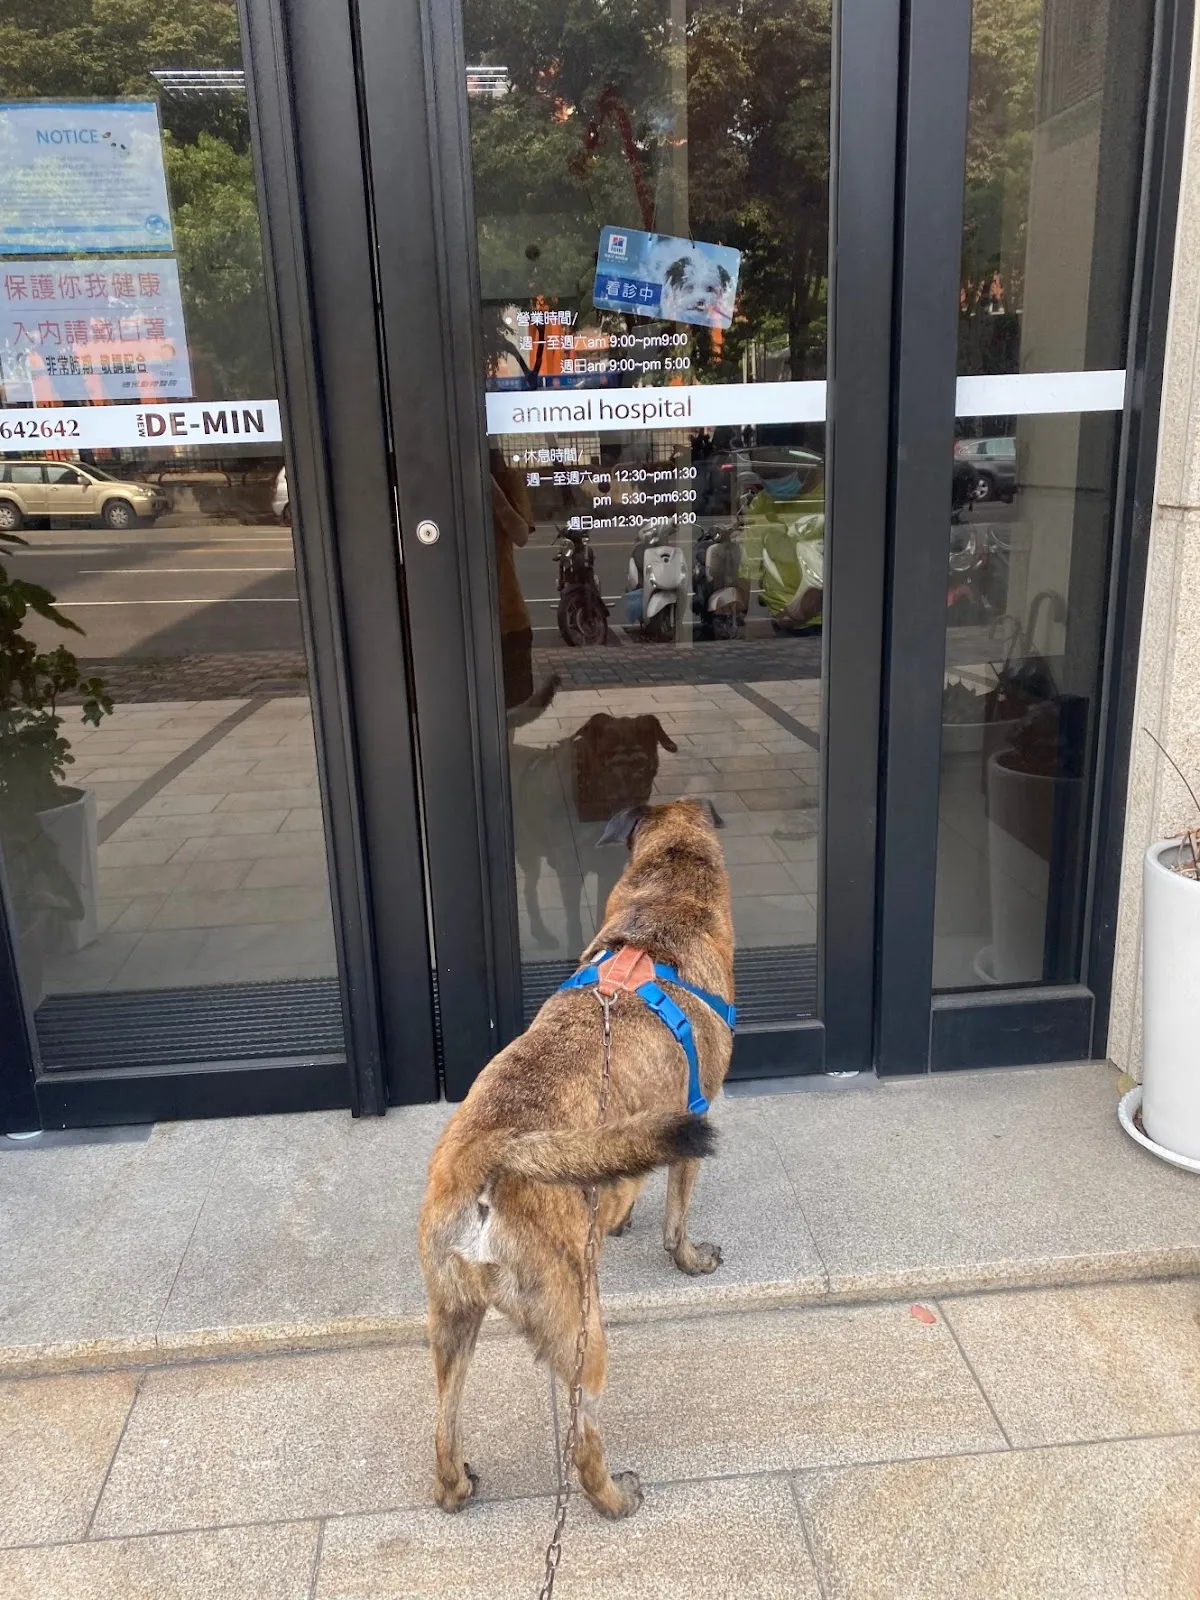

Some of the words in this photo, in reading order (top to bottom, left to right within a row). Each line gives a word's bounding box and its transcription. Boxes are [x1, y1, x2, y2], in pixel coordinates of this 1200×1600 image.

[36, 128, 100, 145] NOTICE
[4, 272, 162, 300] 保護你我健康
[606, 280, 653, 302] 看診中
[12, 318, 167, 345] 入內請戴口罩
[609, 332, 688, 349] 9:00~pm9:00
[609, 358, 661, 373] 9:00~pm
[664, 356, 691, 370] 5:00
[512, 399, 592, 423] animal
[599, 396, 692, 424] hospital
[0, 419, 80, 440] 642642
[136, 413, 146, 437] NEW
[145, 409, 265, 437] DE-MIN
[614, 466, 697, 483] 12:30~pm1:30
[593, 496, 612, 508] pm
[621, 489, 697, 506] 5:30~pm6:30
[672, 512, 697, 524] 1:30
